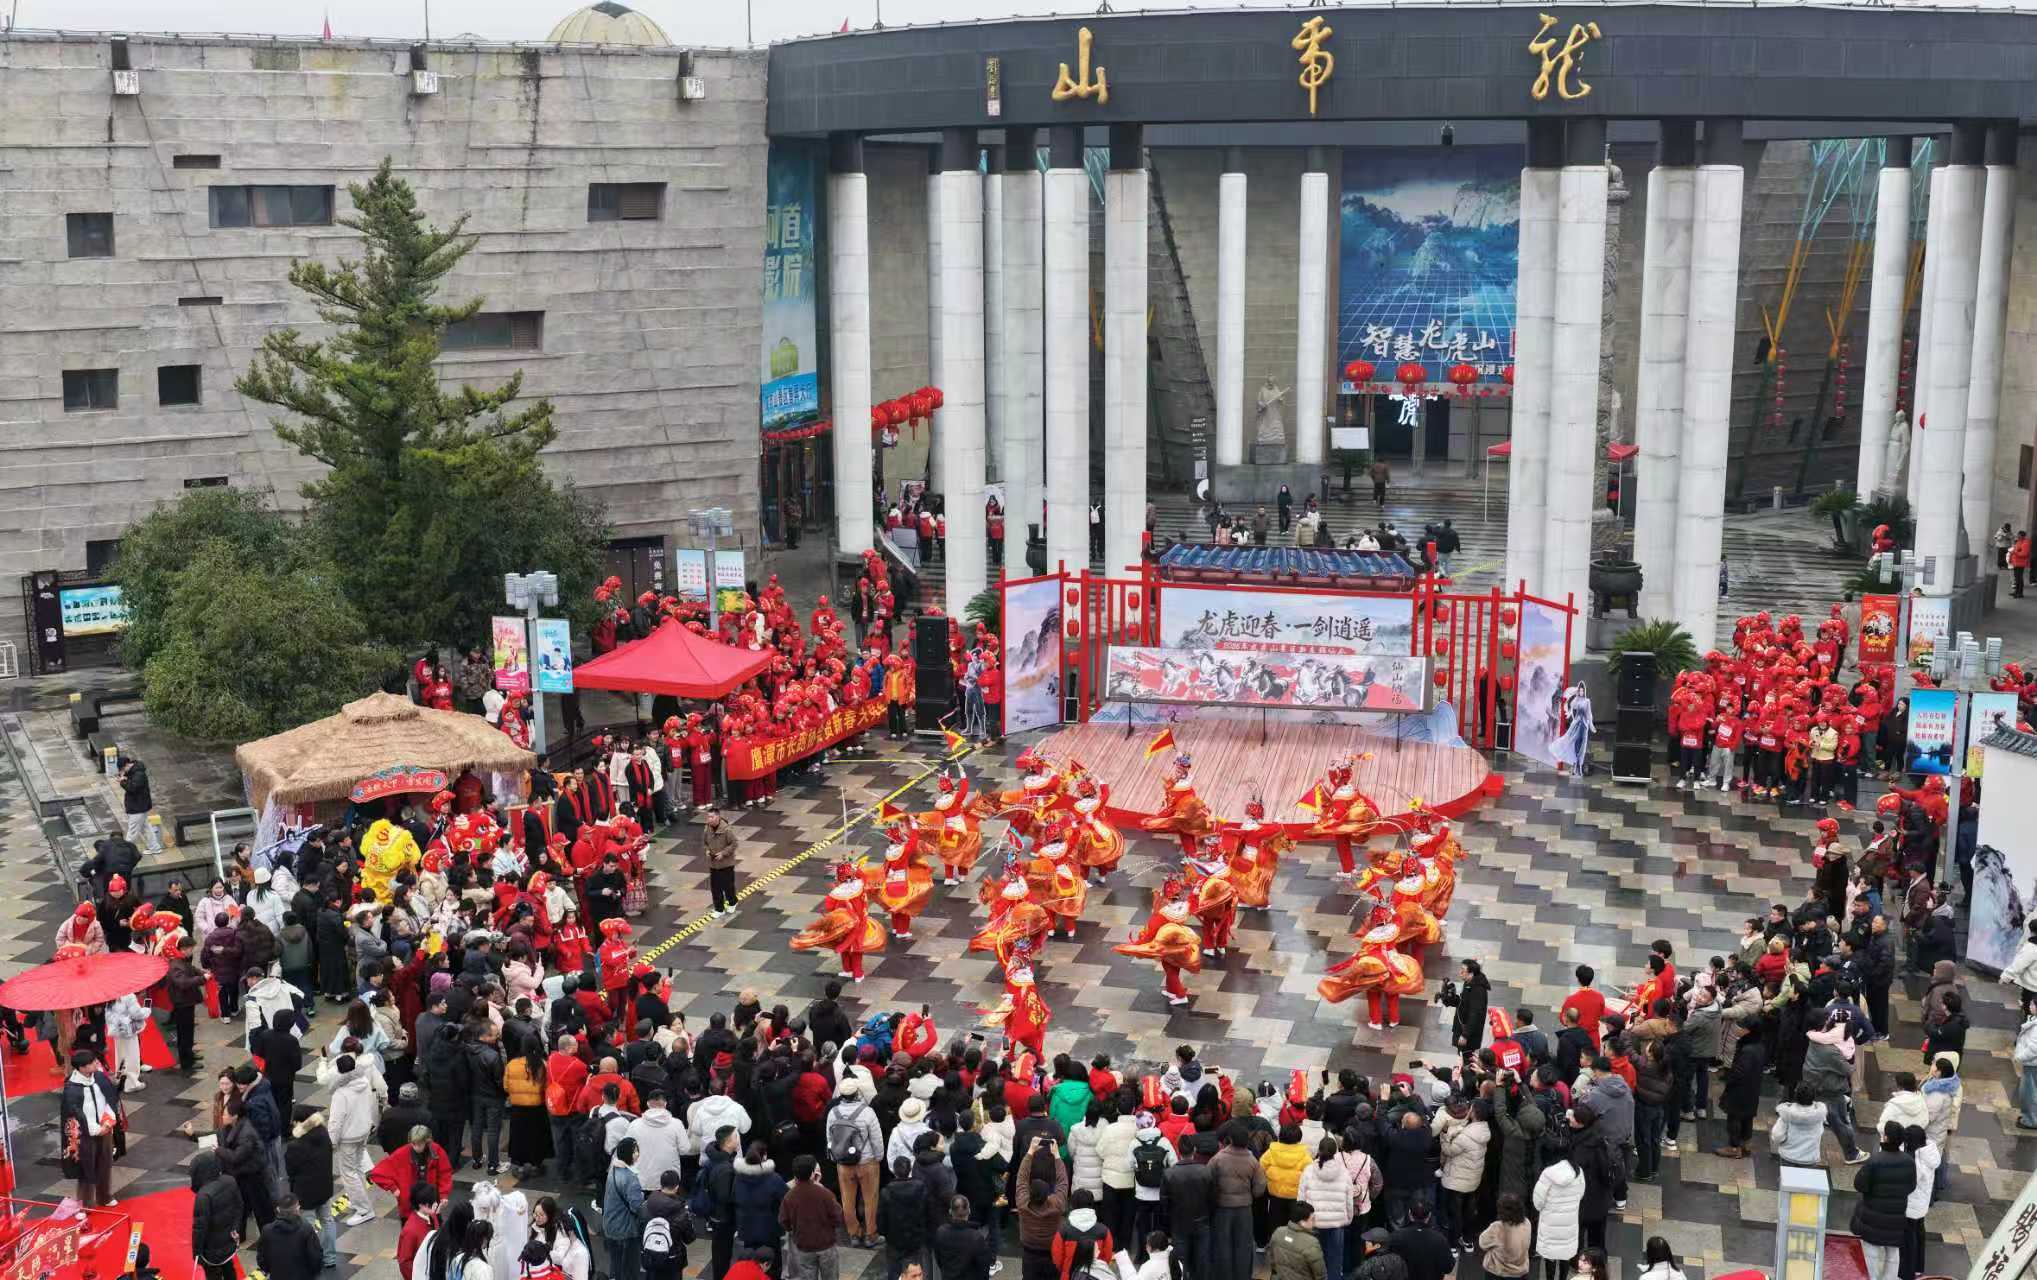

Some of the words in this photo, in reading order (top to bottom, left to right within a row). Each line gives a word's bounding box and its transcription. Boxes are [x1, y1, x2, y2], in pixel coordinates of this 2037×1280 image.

[1051, 26, 1109, 104] 山
[1360, 318, 1496, 362] 智慧龙虎山
